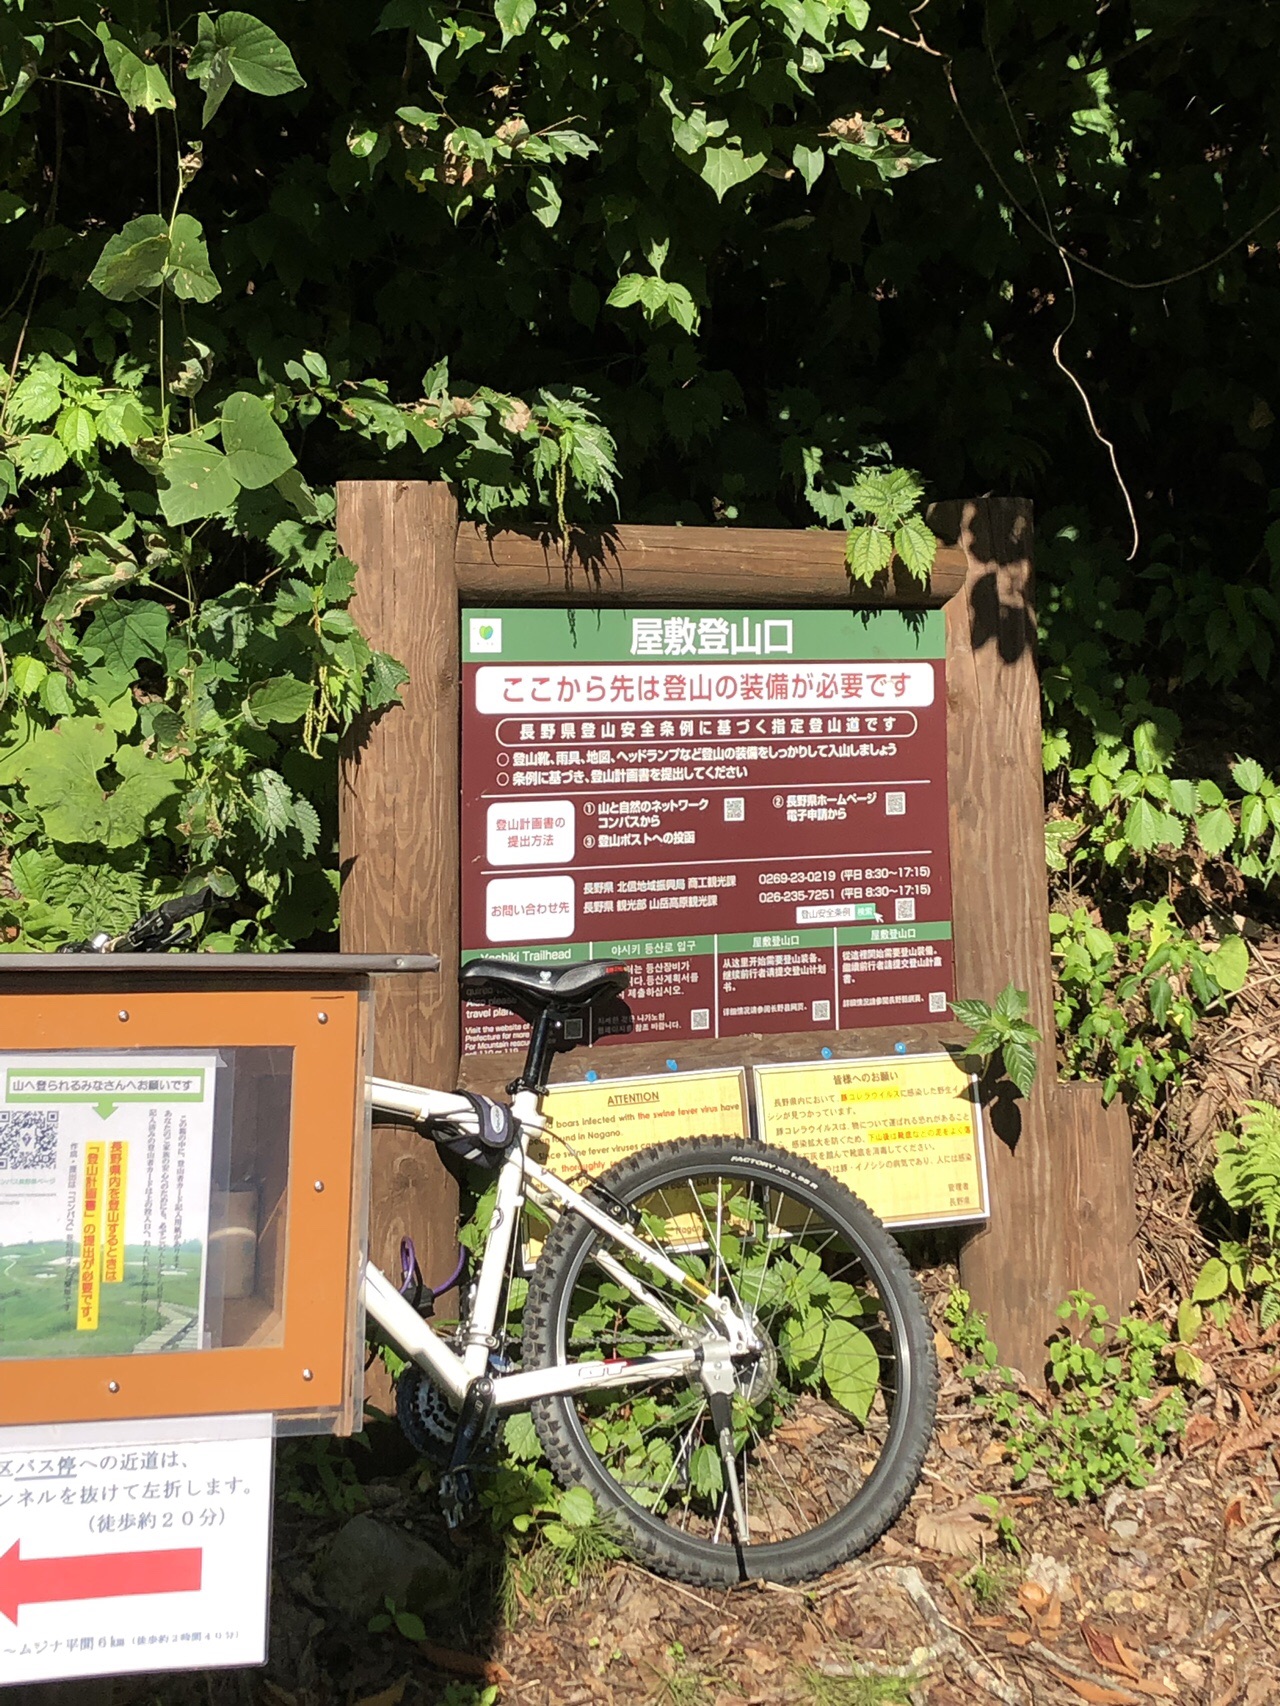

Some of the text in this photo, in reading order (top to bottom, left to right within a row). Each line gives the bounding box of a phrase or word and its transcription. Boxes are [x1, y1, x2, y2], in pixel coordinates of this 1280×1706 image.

[630, 617, 794, 656] 屋敷登山口
[503, 671, 911, 703] ここから先は登山の装備が必要です
[519, 716, 897, 740] 長野県登山安全条例に基づく指定登山道です
[598, 815, 660, 829] コンパスから
[786, 808, 846, 822] 電子申請から
[496, 816, 565, 831] 登山計画書の
[507, 834, 554, 847] 提出方法
[758, 870, 836, 885] 0269-23-0219
[759, 889, 835, 903] 026-235-7251
[491, 901, 570, 917] お問い合わせ先
[753, 936, 800, 948] 屋敷登山口
[870, 929, 916, 941] 屋敷登山口
[522, 948, 571, 961] Trailhead
[611, 941, 696, 955] 야시키 등산로 입구
[466, 1009, 491, 1019] travel
[13, 1079, 193, 1092] 山へ登られるみなさんへお願いです
[833, 1072, 899, 1085] 皆様へのお願い
[607, 1092, 660, 1105] ATTENTION
[556, 1120, 580, 1128] boars
[582, 1115, 616, 1125] infected
[618, 1113, 635, 1122] with
[638, 1112, 650, 1120] the
[653, 1109, 676, 1119] swine
[677, 1107, 698, 1117] fever
[700, 1105, 718, 1114] virus
[720, 1102, 740, 1112] have
[768, 1107, 857, 1121] シシが見つかっています。
[588, 1146, 610, 1155] fever
[612, 1143, 639, 1152] viruses
[730, 1155, 776, 1169] FACTORY
[775, 1166, 791, 1175] XC
[948, 1182, 969, 1192] 管理者
[950, 1196, 970, 1206] 長野県
[105, 1141, 123, 1281] 長野県内を登山するときは
[81, 1146, 99, 1323] 「登山計画書」の提出が必要です。
